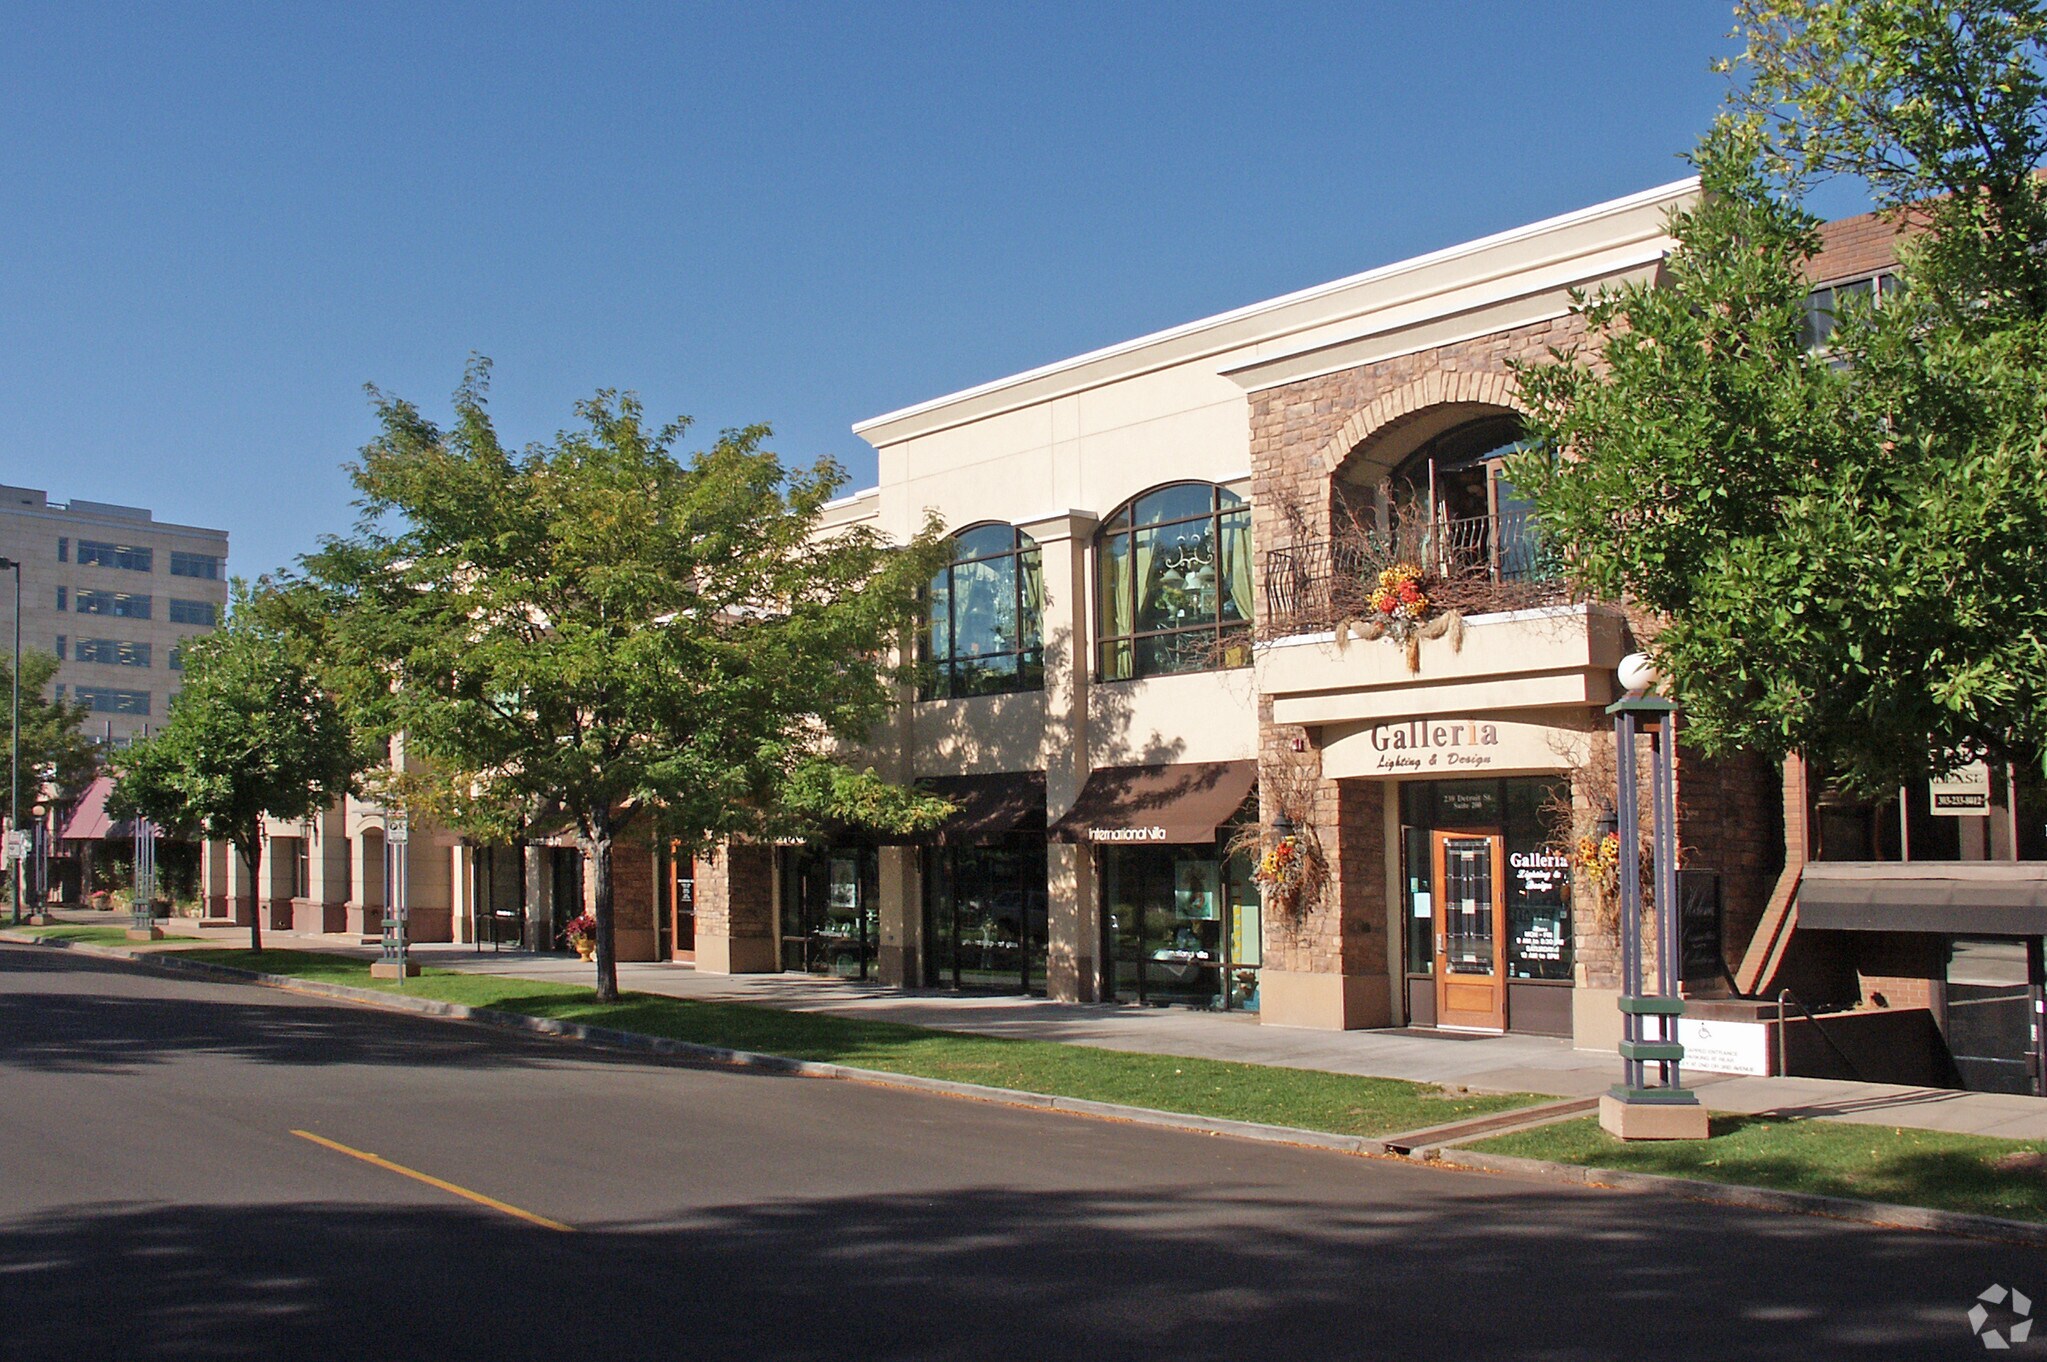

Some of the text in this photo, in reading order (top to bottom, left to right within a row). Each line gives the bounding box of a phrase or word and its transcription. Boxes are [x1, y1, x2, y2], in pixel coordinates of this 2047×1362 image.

[1371, 717, 1498, 751] Galleria
[1377, 753, 1491, 771] Lighting & Design
[1510, 852, 1568, 868] Galleria
